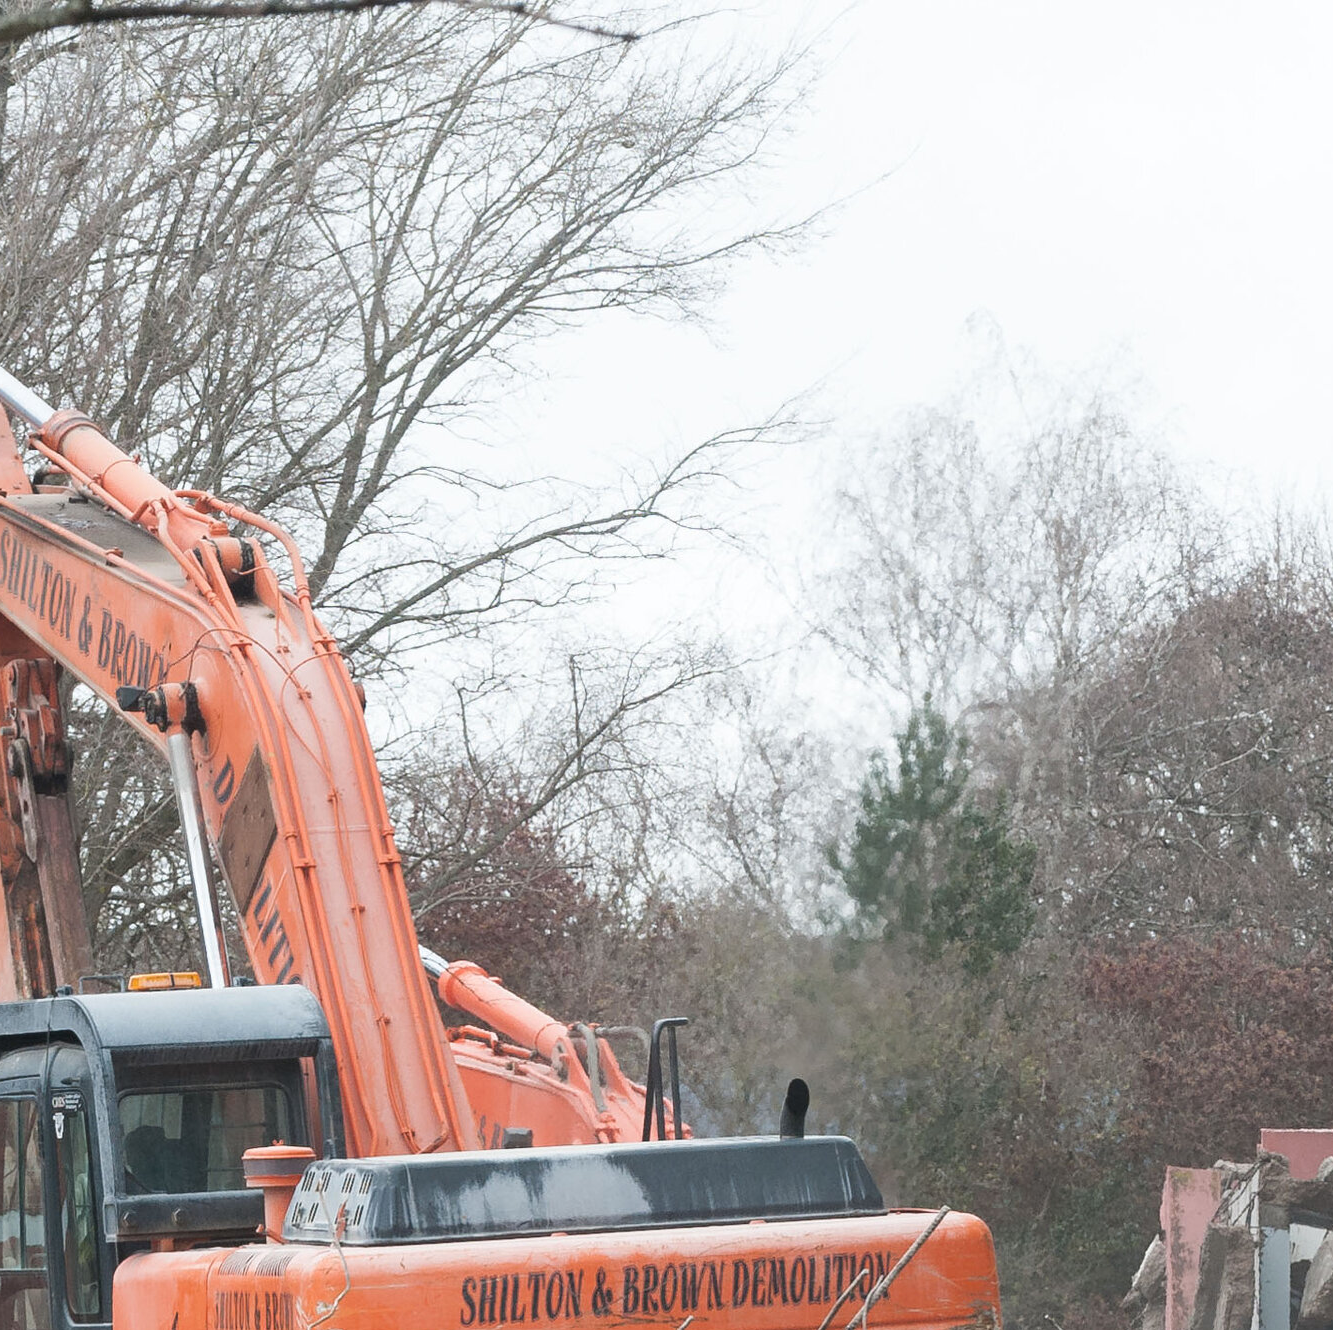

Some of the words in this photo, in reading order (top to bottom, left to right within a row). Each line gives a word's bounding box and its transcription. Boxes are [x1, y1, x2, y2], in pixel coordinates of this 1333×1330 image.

[78, 595, 93, 656] &
[460, 1268, 583, 1326] SHILTON
[592, 1266, 612, 1316] &
[623, 1260, 725, 1317] BROWN
